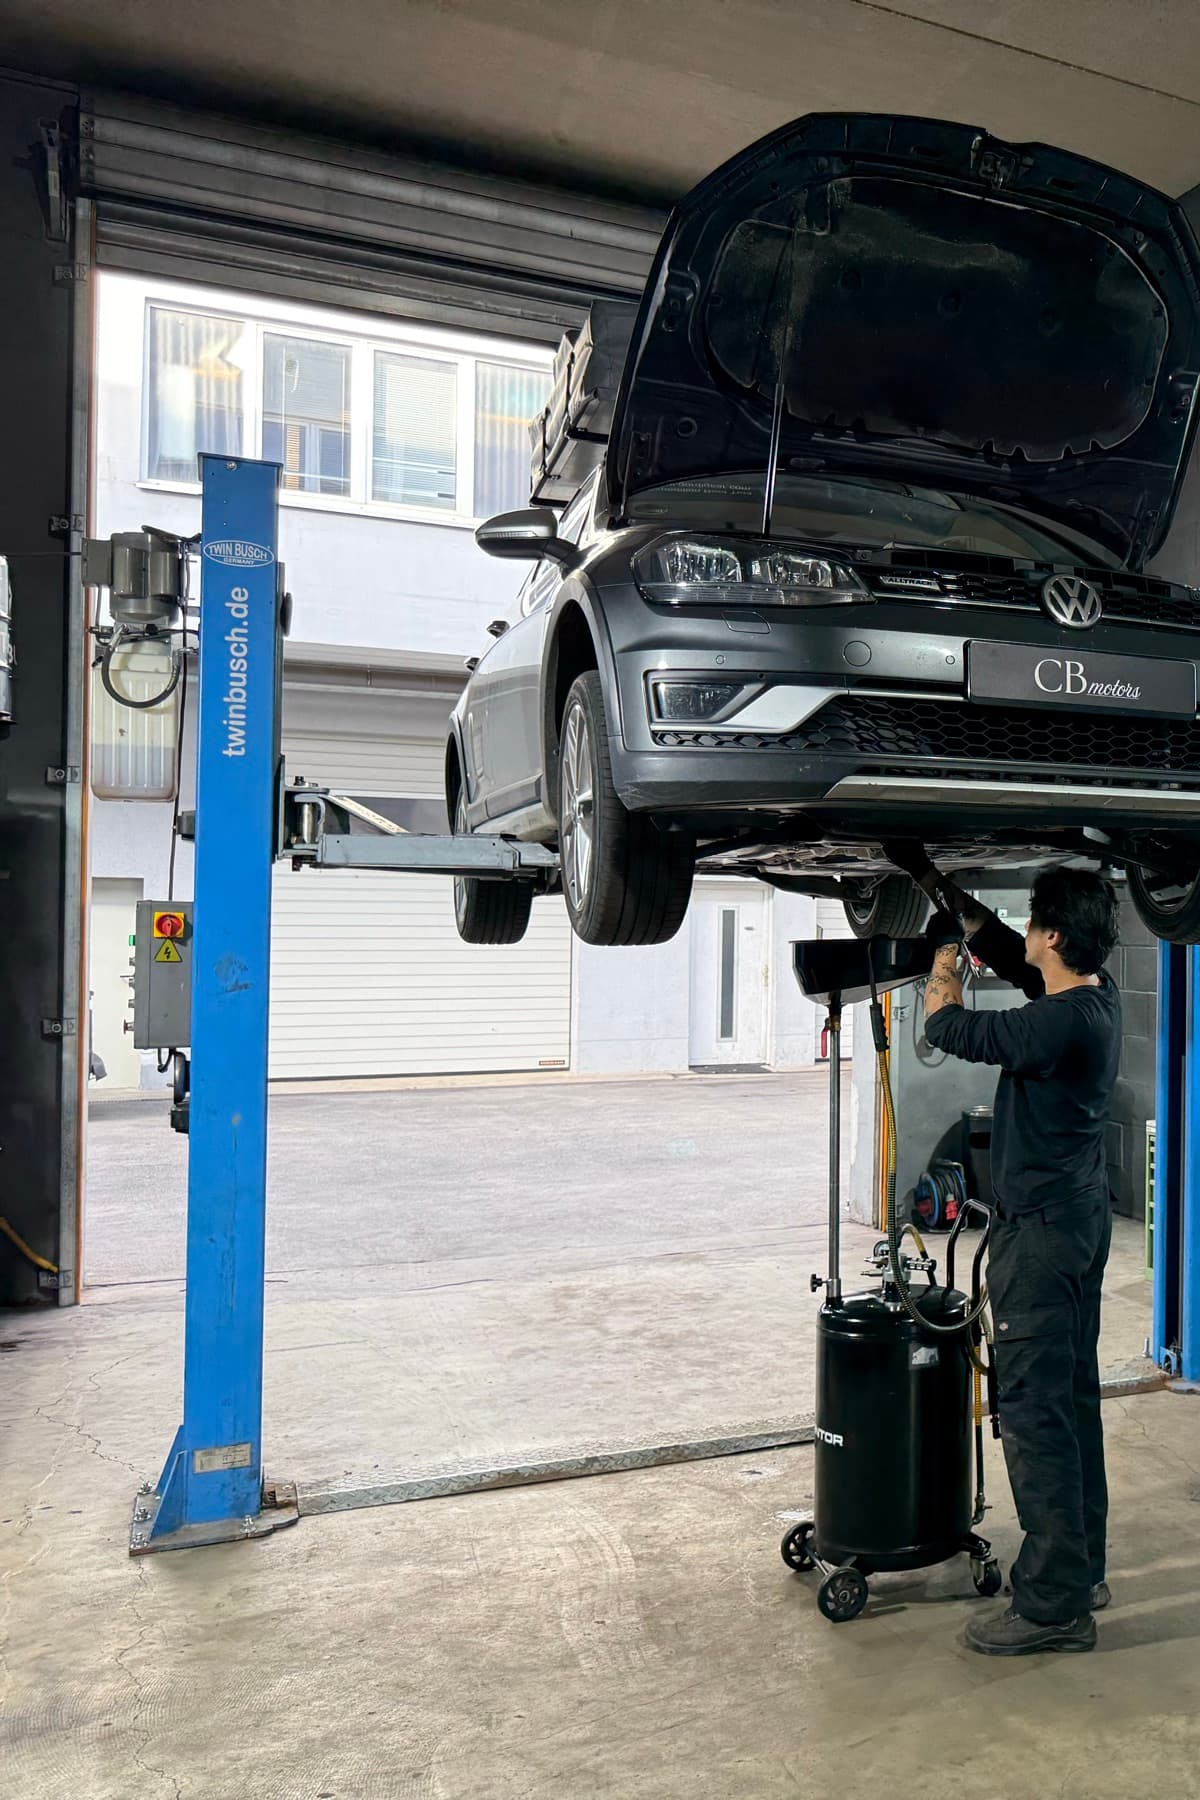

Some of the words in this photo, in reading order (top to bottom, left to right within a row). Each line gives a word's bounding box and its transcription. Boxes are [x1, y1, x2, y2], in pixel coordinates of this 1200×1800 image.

[208, 542, 232, 556] TWIN
[235, 543, 267, 560] BUSCH
[222, 586, 249, 758] twinbusch.de
[1034, 658, 1087, 694] CB
[1087, 679, 1141, 698] motors
